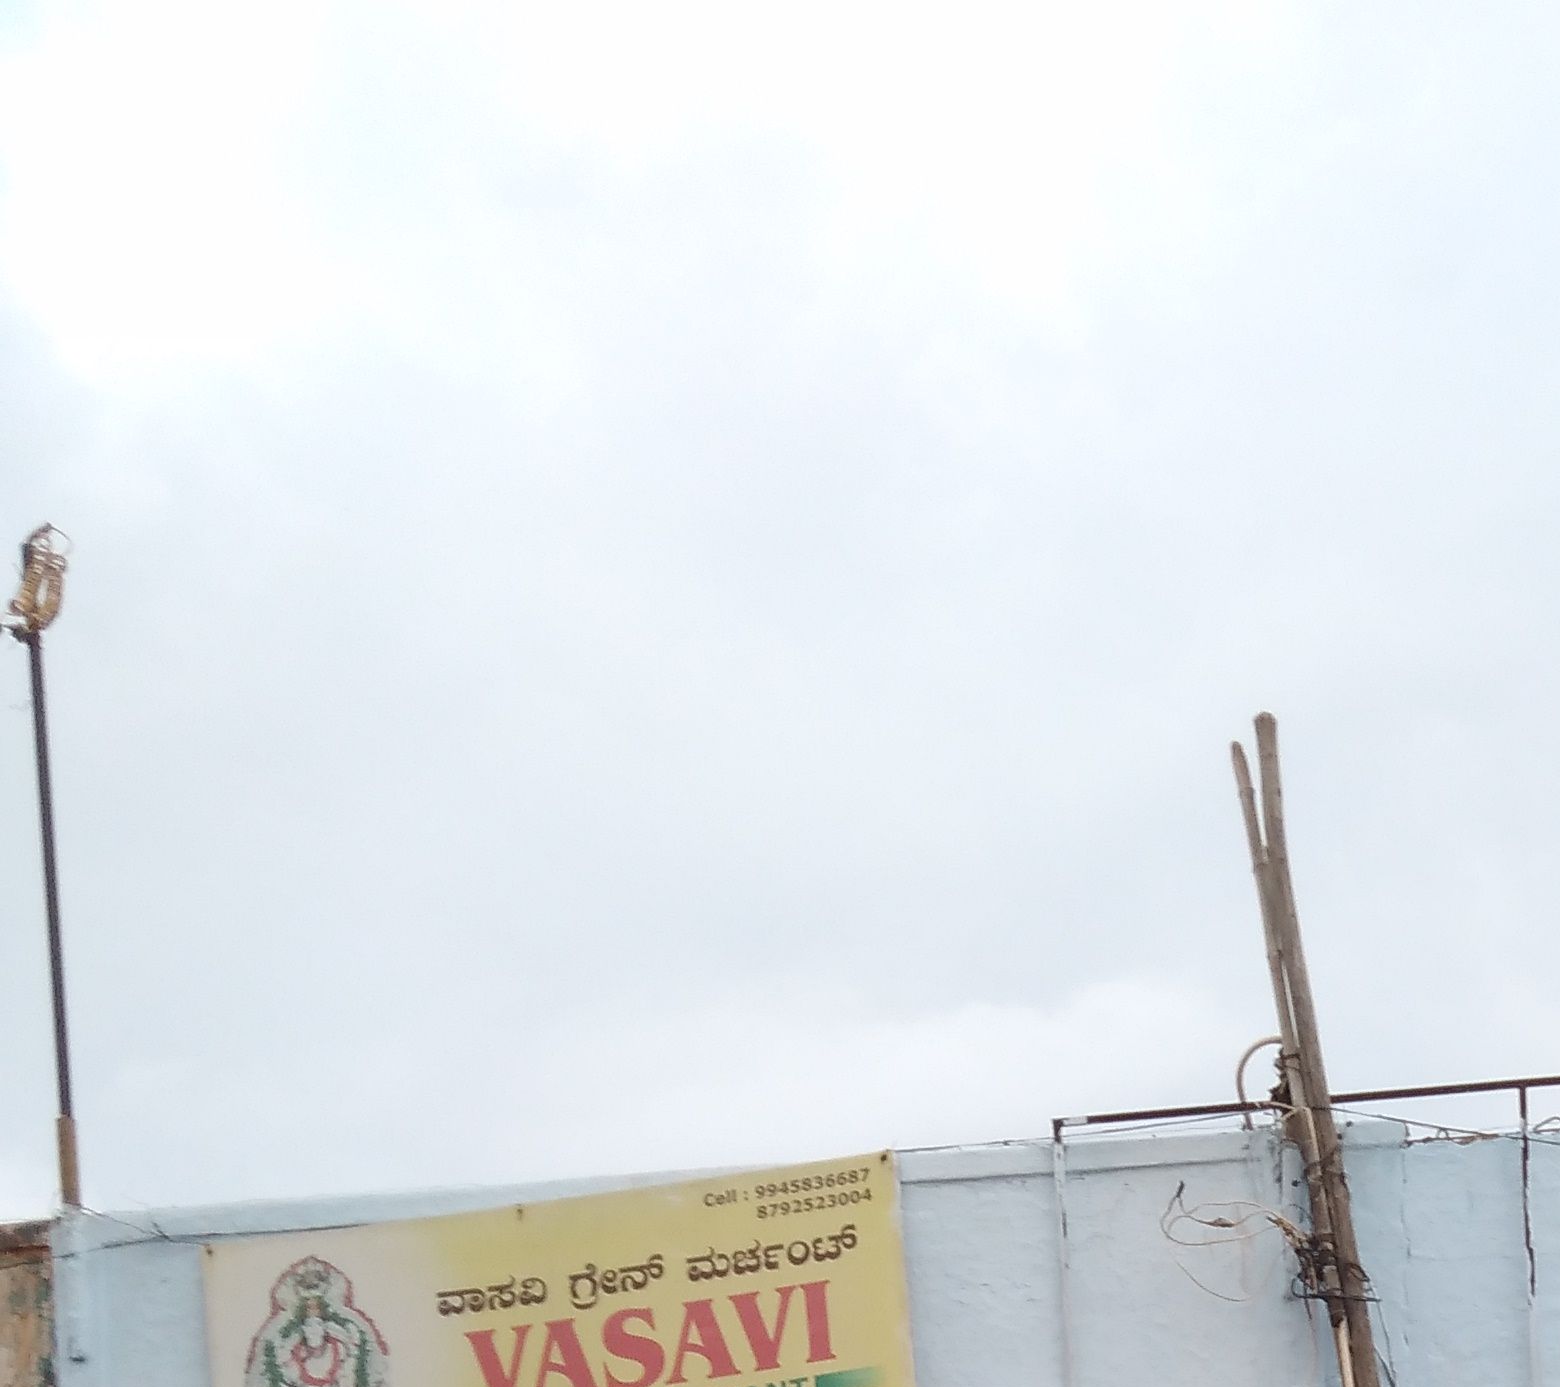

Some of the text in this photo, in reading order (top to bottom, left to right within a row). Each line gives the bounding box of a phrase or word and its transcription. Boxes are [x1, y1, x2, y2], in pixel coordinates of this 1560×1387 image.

[703, 1189, 737, 1207] Cell
[755, 1167, 870, 1199] 9945836687
[756, 1188, 872, 1219] 8792523004
[436, 1275, 548, 1317] ವಾಸವಿ
[567, 1254, 664, 1310] ಗ್ರೇನ್
